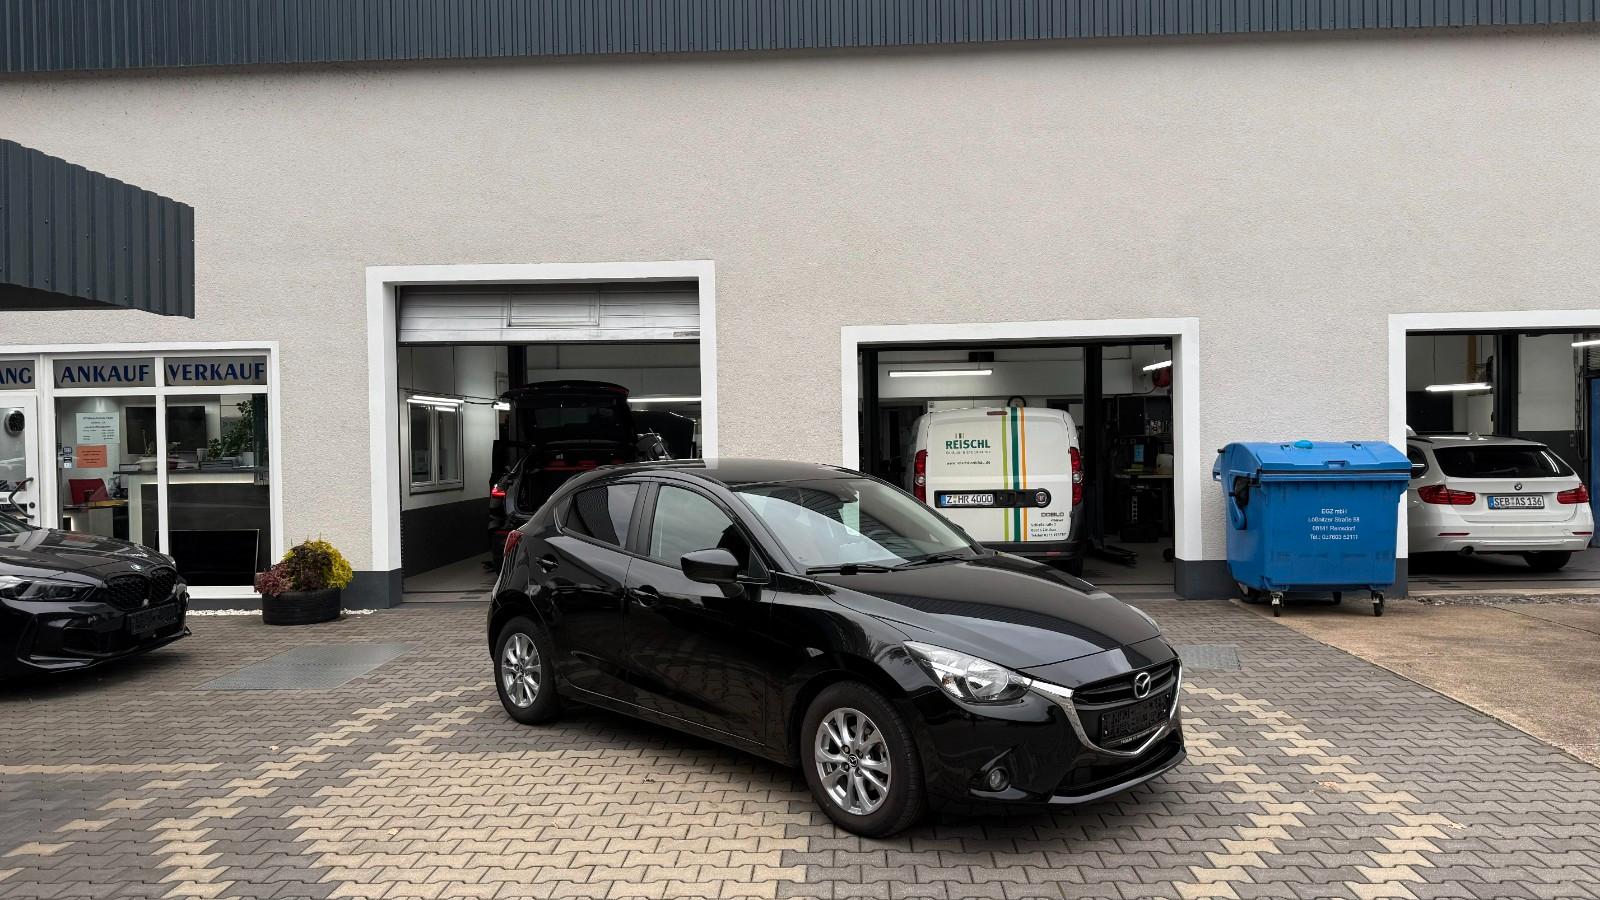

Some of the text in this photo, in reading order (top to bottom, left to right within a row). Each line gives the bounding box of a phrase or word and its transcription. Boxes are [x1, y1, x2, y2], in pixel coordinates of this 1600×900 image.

[60, 364, 149, 383] ANKAUF
[168, 362, 265, 382] VERKAUF
[945, 439, 991, 450] REISCHL
[946, 494, 993, 504] Z HR 4000
[1494, 497, 1542, 506] SEB AS 136
